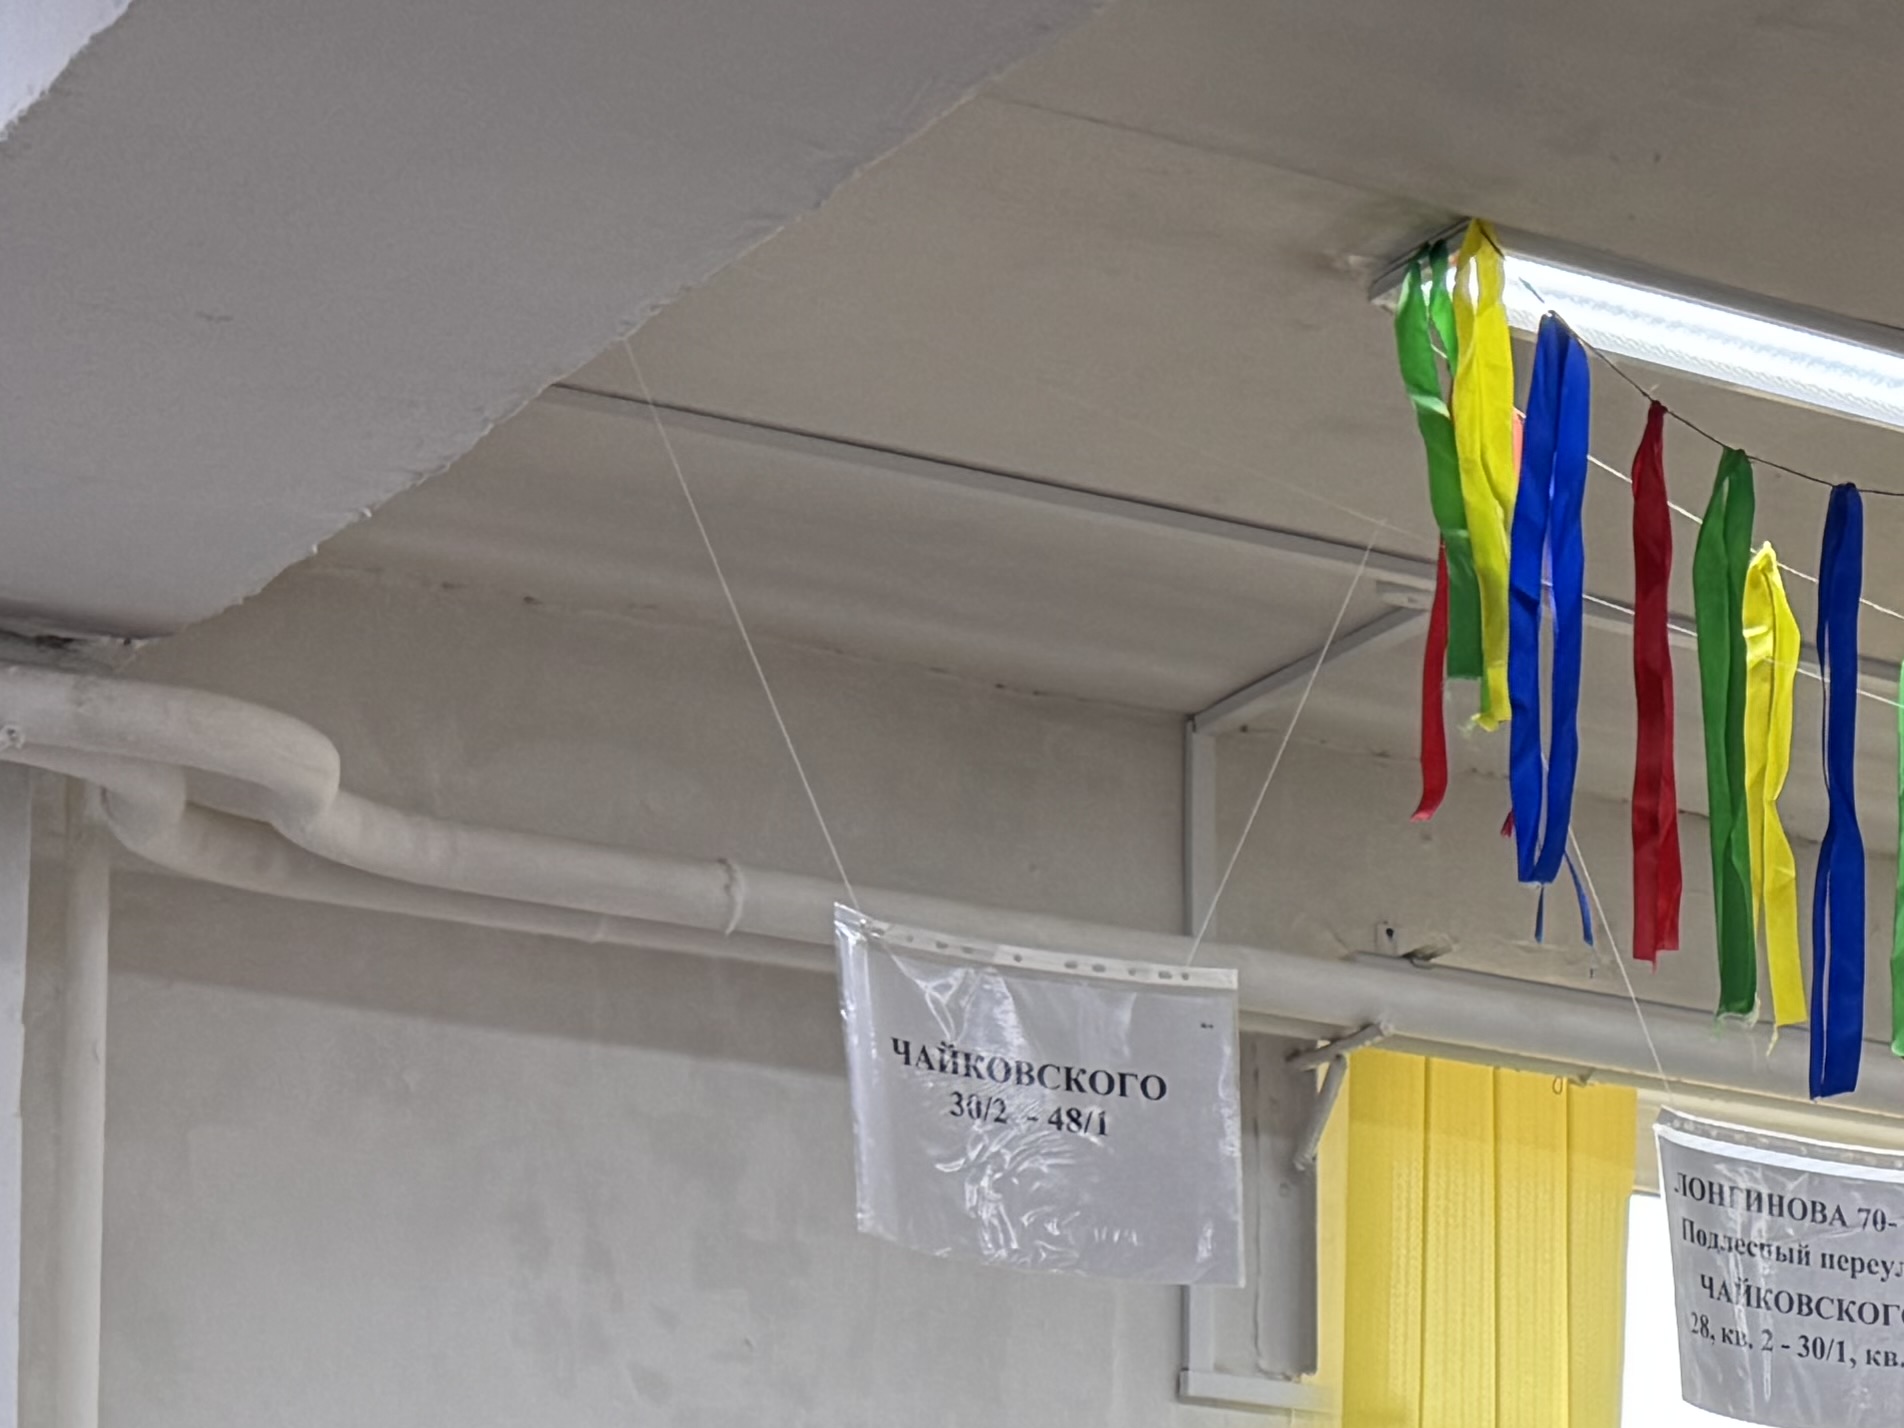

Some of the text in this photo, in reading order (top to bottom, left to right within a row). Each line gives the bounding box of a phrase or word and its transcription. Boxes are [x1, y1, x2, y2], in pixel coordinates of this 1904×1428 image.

[891, 1037, 1167, 1100] ЧАЙКОВСКОГО
[1048, 1107, 1107, 1136] 48/1
[1674, 1172, 1848, 1228] ЛОНГИНОВА
[1682, 1218, 1811, 1267] Подлесный
[1761, 1329, 1774, 1351] 2
